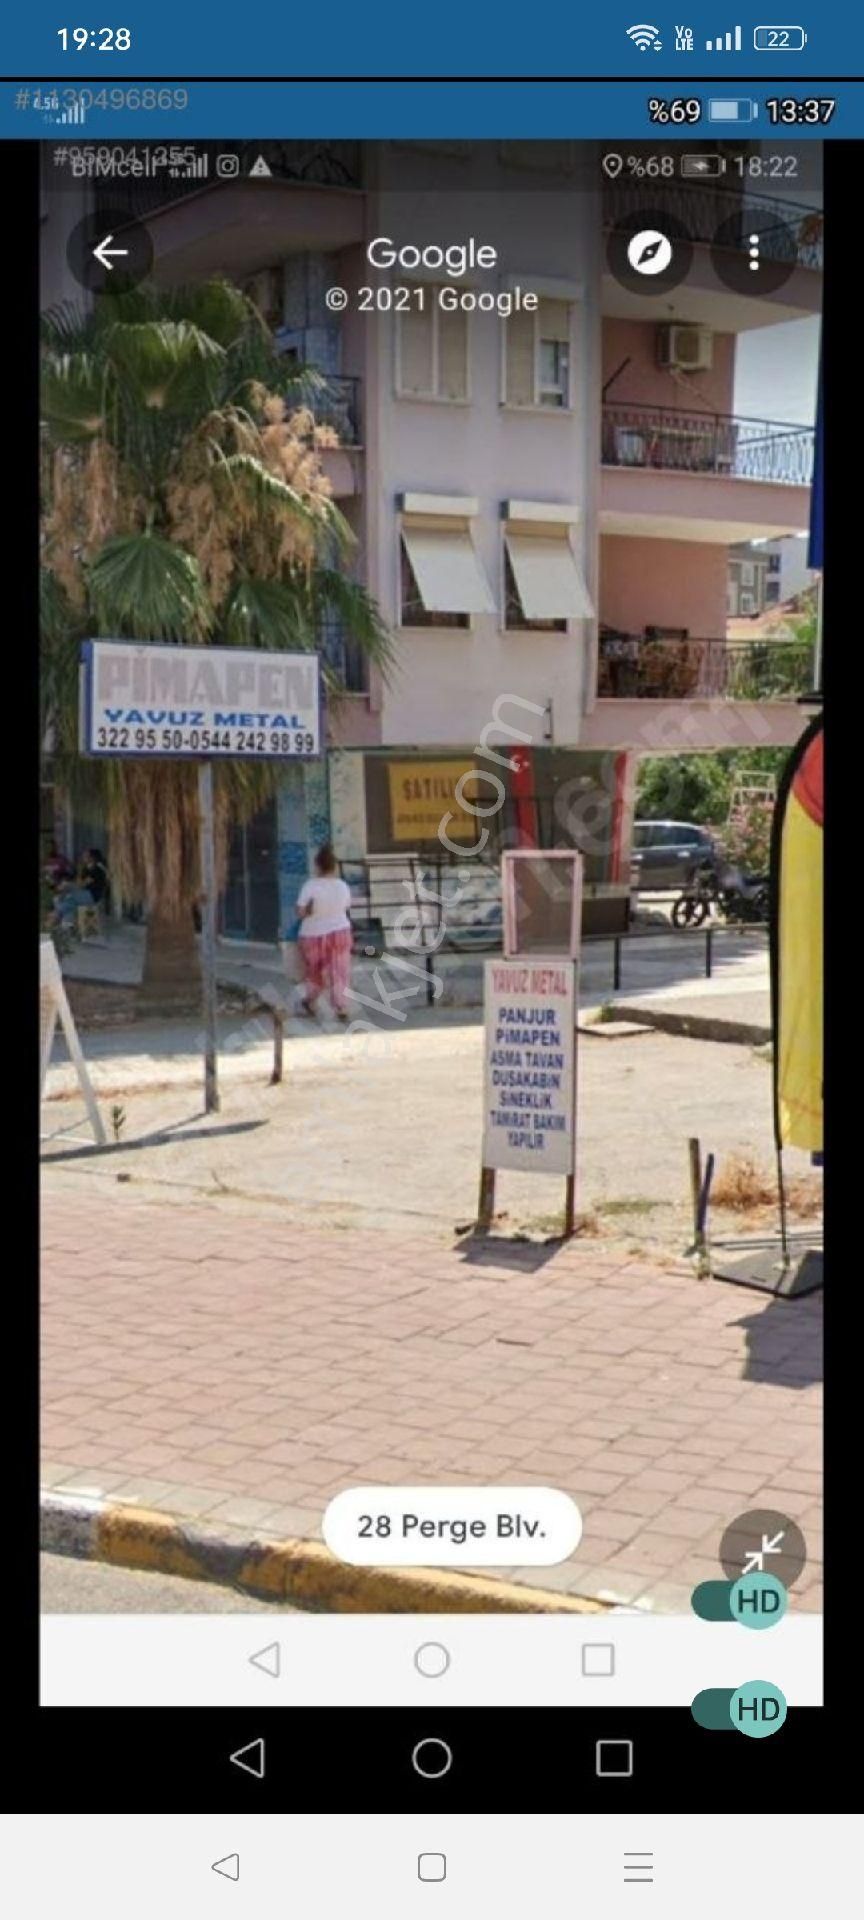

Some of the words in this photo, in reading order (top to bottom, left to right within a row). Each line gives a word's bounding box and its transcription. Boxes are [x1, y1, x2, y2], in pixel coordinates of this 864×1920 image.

[57, 28, 131, 51] 19:28
[675, 26, 693, 38] Vo
[768, 31, 790, 47] 22
[675, 38, 694, 51] LTE
[649, 100, 701, 122] %69
[767, 100, 835, 122] 13:37
[627, 156, 674, 177] %68
[734, 156, 798, 177] 18:22
[367, 238, 497, 276] Google
[357, 288, 424, 311] 2021
[439, 286, 538, 317] Google
[105, 709, 205, 725] YAVUZ
[214, 713, 305, 729] METAL
[98, 728, 129, 748] 322
[135, 730, 156, 749] 95
[162, 730, 231, 750] 50-0544
[237, 732, 265, 751] 242
[270, 733, 290, 752] 98
[294, 734, 315, 753] 99
[493, 969, 529, 994] YAVUZ
[531, 969, 567, 996] METAL
[499, 1007, 556, 1026] PANJUR
[490, 1049, 522, 1067] ASMA
[525, 1052, 565, 1069] TAVAN
[358, 1515, 391, 1538] 28
[402, 1514, 487, 1544] Perge
[497, 1514, 547, 1538] Blv.
[738, 1589, 780, 1613] HD
[738, 1697, 780, 1721] HD
